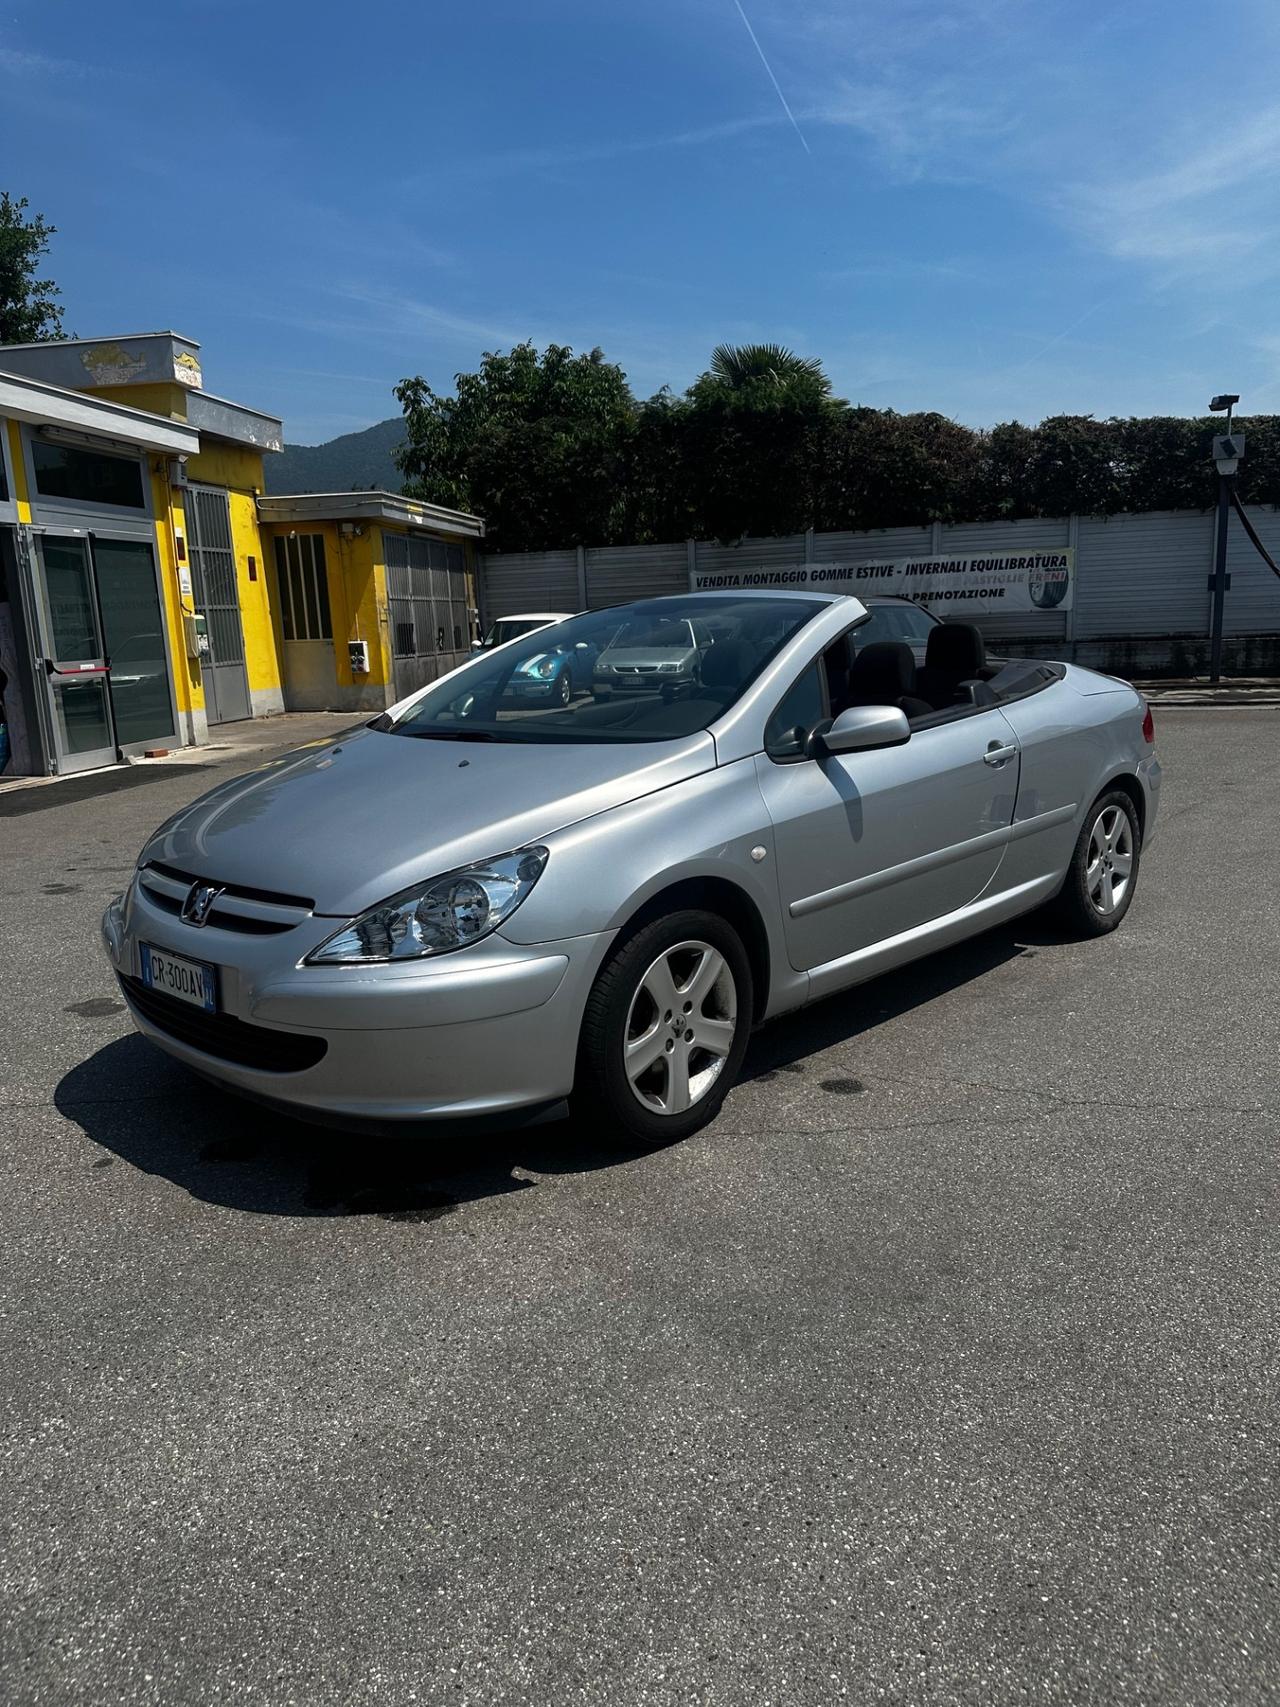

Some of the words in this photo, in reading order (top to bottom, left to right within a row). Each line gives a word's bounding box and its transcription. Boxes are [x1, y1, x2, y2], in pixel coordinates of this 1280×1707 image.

[696, 575, 740, 588] VENDITA
[743, 571, 807, 585] MONTAGGIO
[811, 568, 854, 582] GOMME
[856, 565, 895, 579] ESTIVE
[905, 560, 967, 576] INVERNALI
[970, 555, 1067, 571] EQUILIBRATURA
[1028, 571, 1066, 583] FRENI
[912, 588, 1006, 600] PRENOTAZIONE
